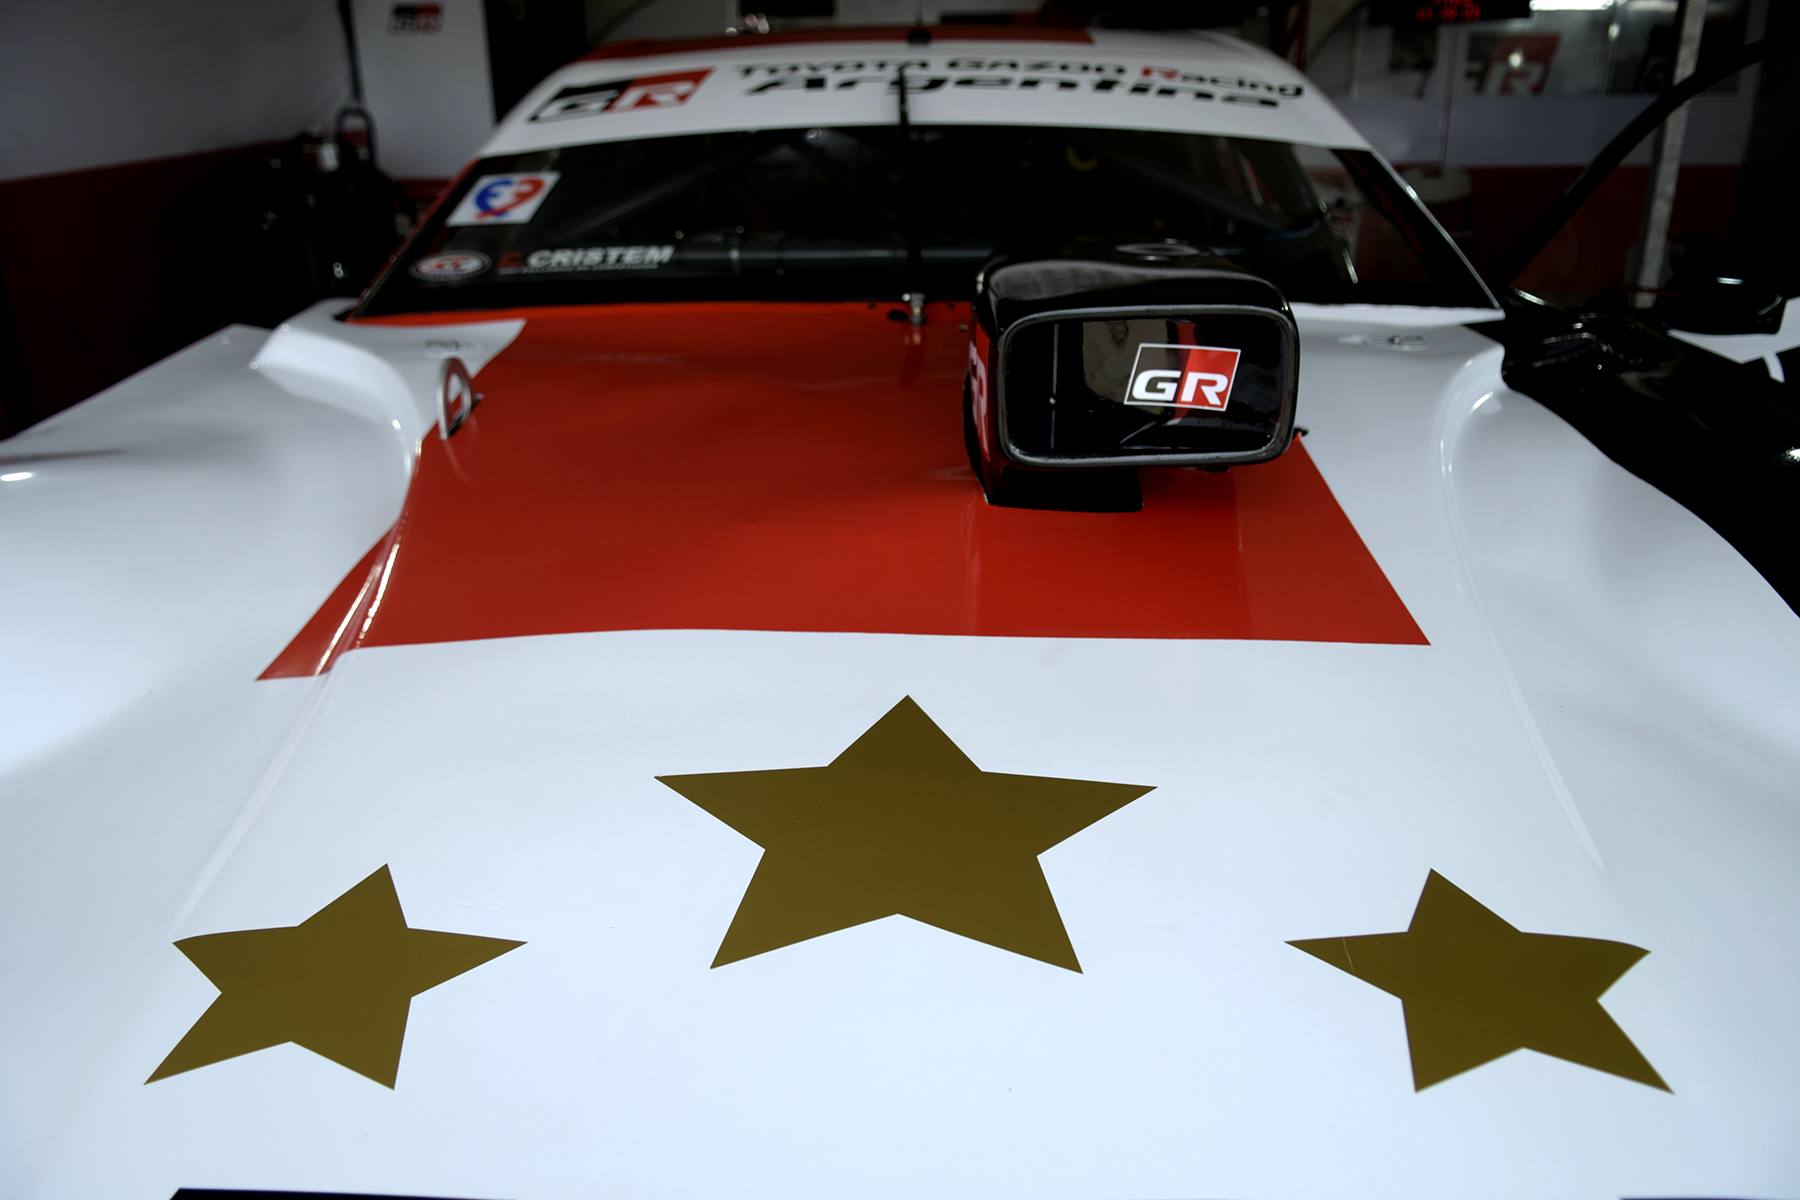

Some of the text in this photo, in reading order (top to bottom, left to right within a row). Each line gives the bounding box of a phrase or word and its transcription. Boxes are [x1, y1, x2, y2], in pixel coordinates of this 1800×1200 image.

[737, 57, 1303, 96] TOYOTA GAZOO Racing
[745, 75, 1280, 107] Argentina
[541, 80, 695, 116] GR
[527, 245, 675, 269] CRISTEM
[1132, 369, 1228, 405] GR
